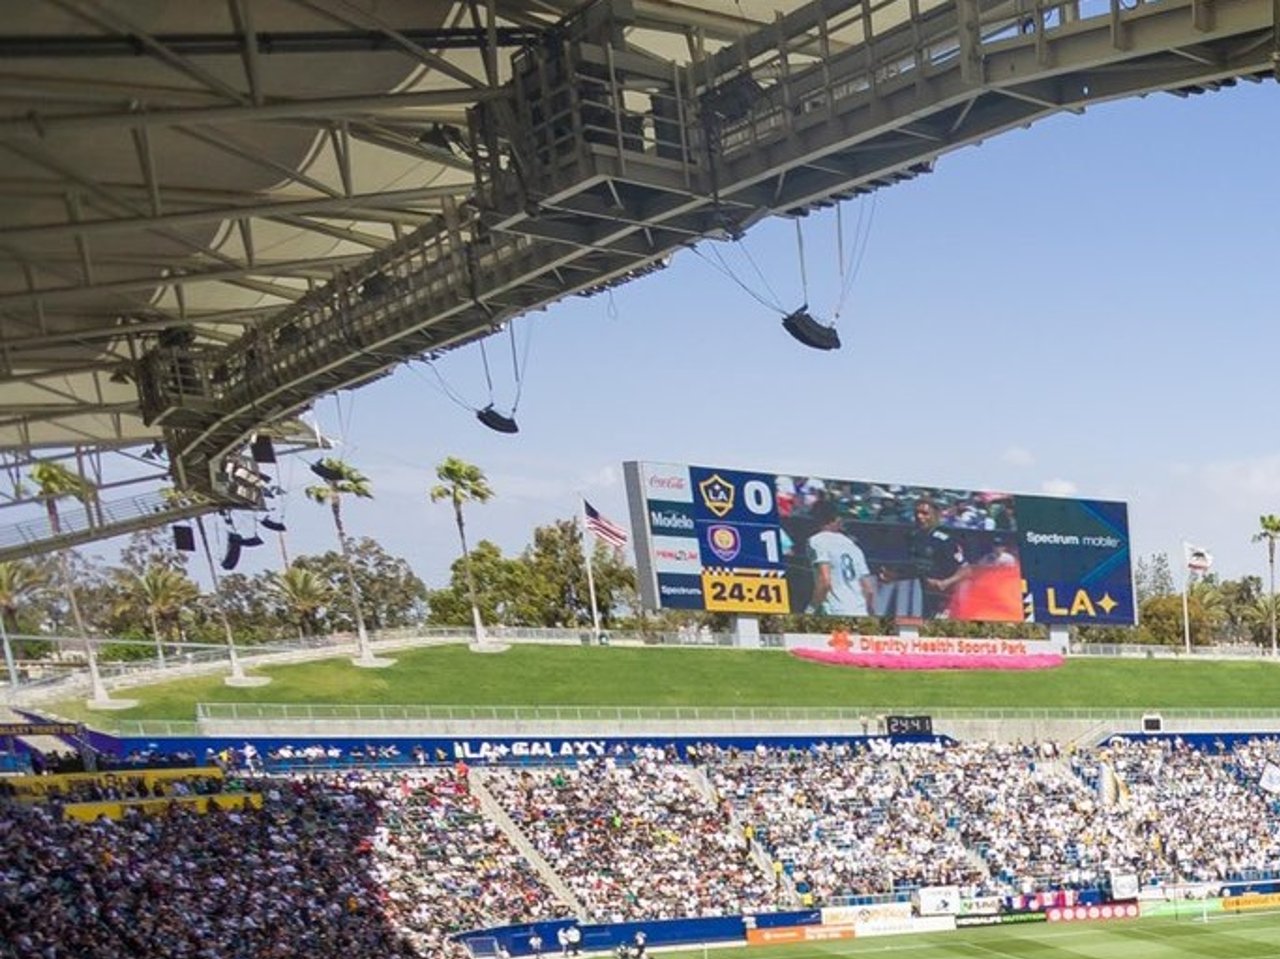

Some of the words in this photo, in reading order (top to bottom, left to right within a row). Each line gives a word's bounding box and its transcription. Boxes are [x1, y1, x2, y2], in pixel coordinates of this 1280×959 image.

[744, 480, 773, 515] 0
[651, 510, 694, 529] Modelo
[760, 530, 779, 563] 1
[1026, 531, 1079, 545] Spectrum
[1082, 535, 1119, 548] mobile
[661, 585, 702, 596] Spectrum
[711, 582, 782, 604] 24:41
[1046, 587, 1097, 617] LA
[860, 637, 908, 655] Dignity
[912, 638, 954, 653] Health
[957, 640, 996, 655] Sports
[1001, 641, 1026, 654] Park
